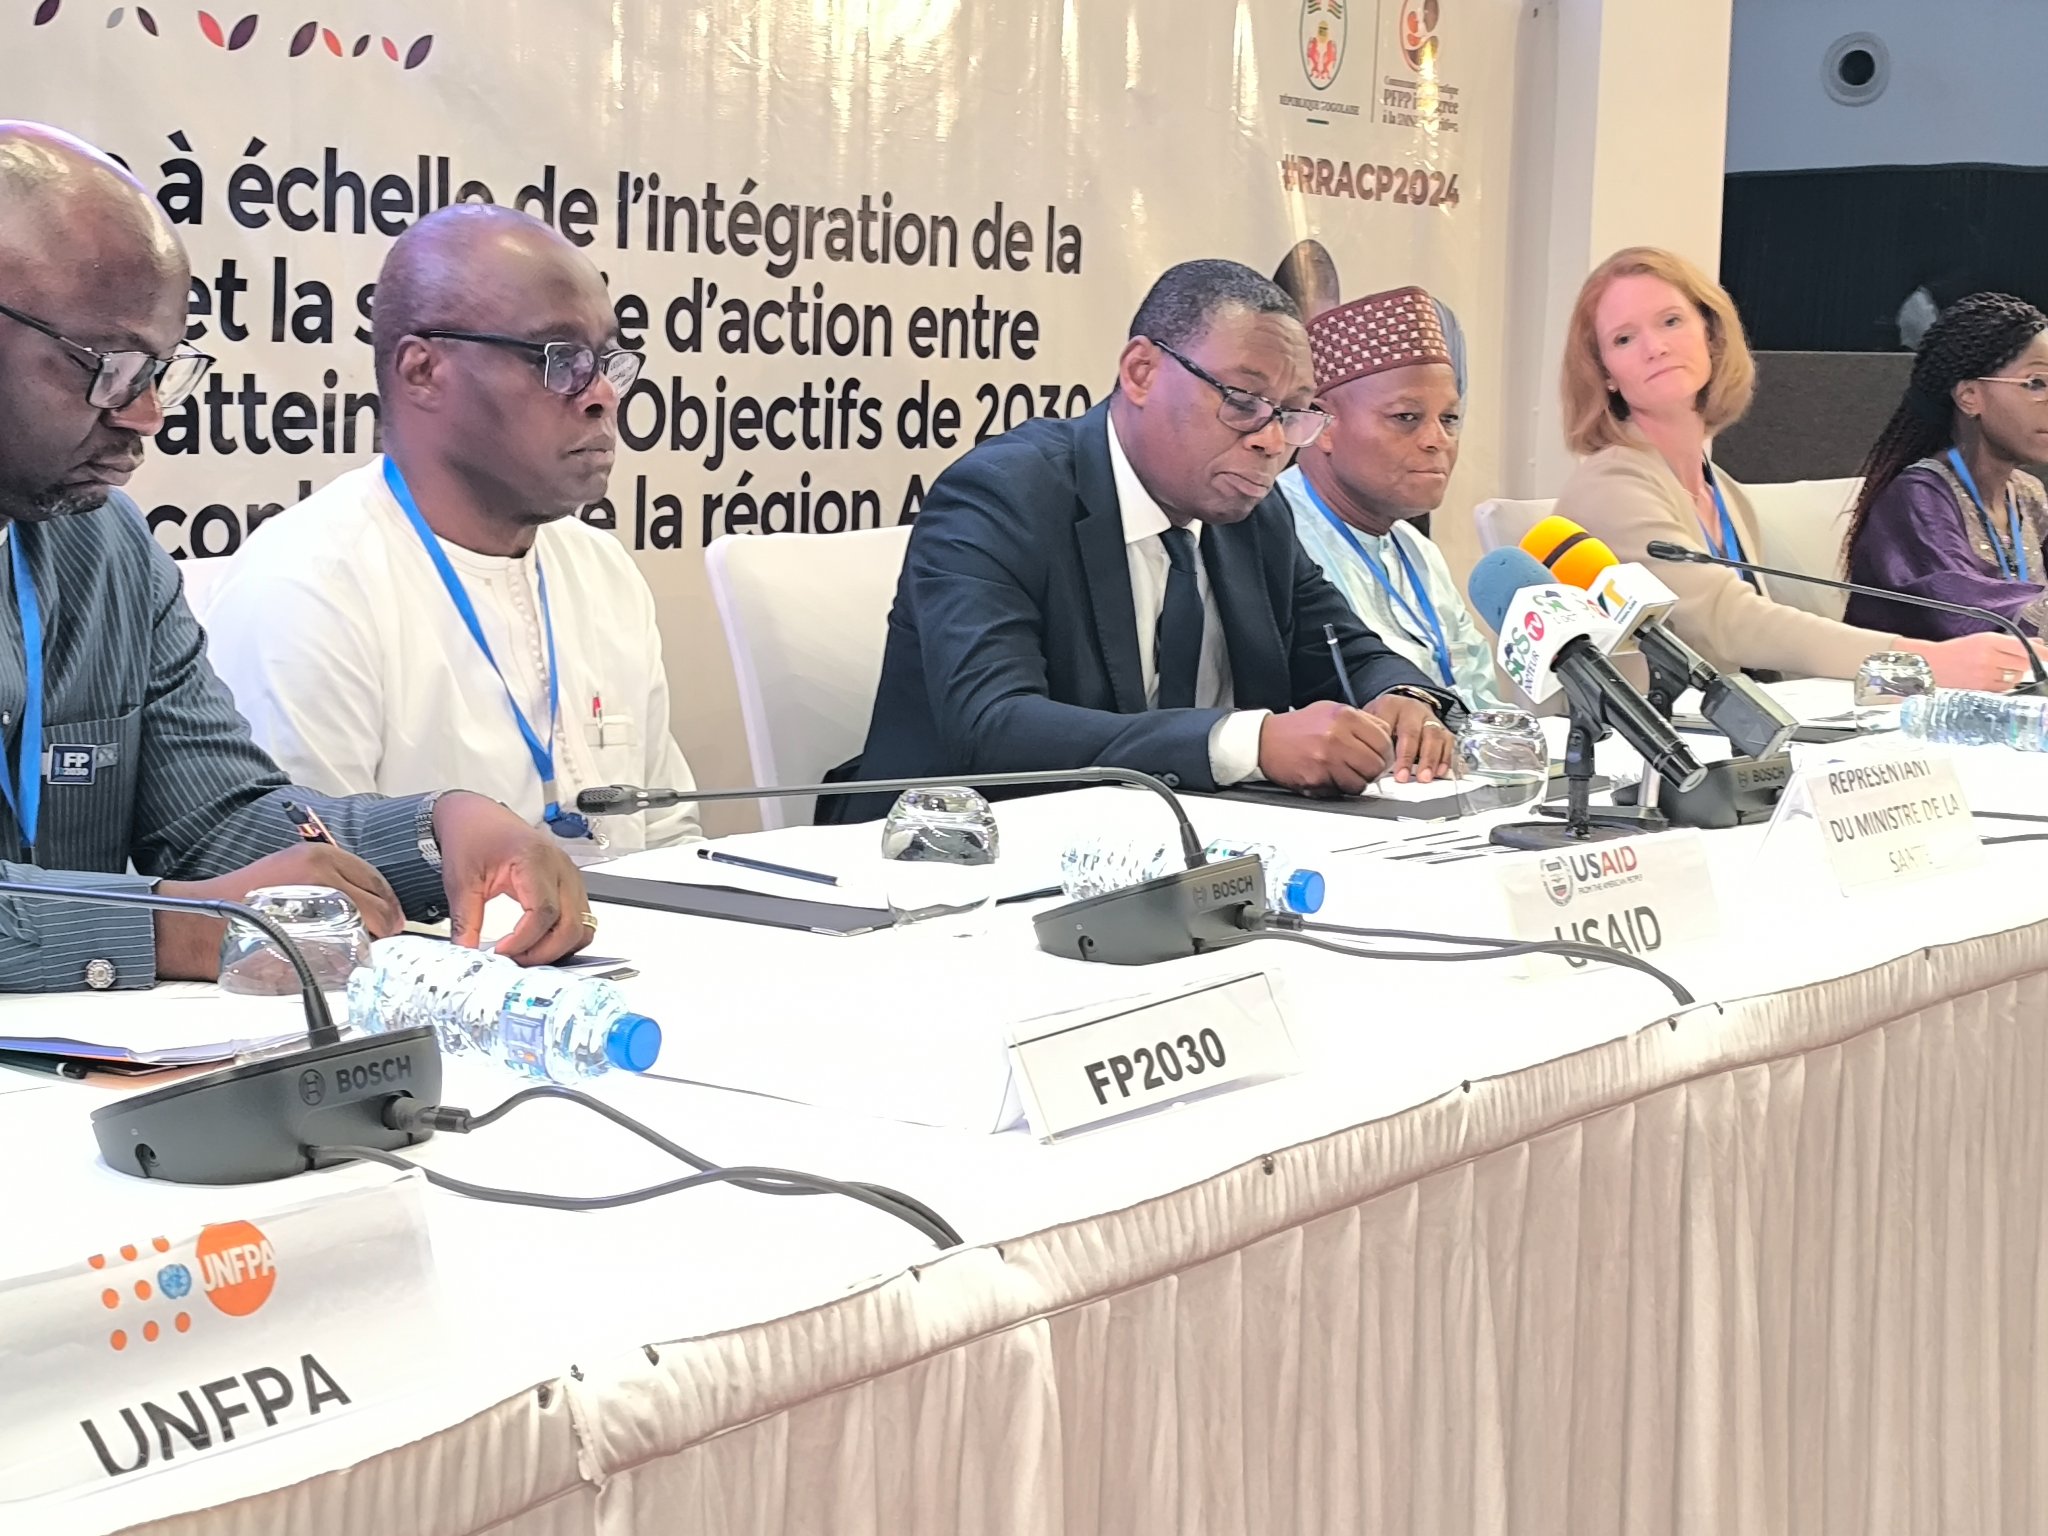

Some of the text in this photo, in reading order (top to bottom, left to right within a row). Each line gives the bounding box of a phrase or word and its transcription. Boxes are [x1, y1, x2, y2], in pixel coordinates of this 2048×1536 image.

[157, 130, 203, 225] à
[514, 165, 598, 247] de
[972, 201, 1033, 271] de
[1046, 206, 1083, 274] la
[1282, 153, 1459, 208] #RRACP2024
[186, 258, 249, 342] et
[271, 256, 333, 344] la
[908, 294, 1040, 360] entre
[617, 376, 883, 470] Objectifs
[897, 380, 962, 449] de
[635, 475, 682, 550] la
[702, 470, 881, 548] région
[63, 752, 90, 768] FP
[1753, 766, 1785, 783] BOSCH
[1829, 793, 1961, 842] DU MINISTRE DE LA
[1211, 875, 1254, 901] BOSCH
[1569, 846, 1637, 881] USAID
[1554, 906, 1662, 968] USAID
[335, 1055, 413, 1094] BOSCH
[1084, 1027, 1227, 1106] FP2030
[202, 1238, 277, 1292] UNFPA
[80, 1353, 353, 1477] UNFPA
